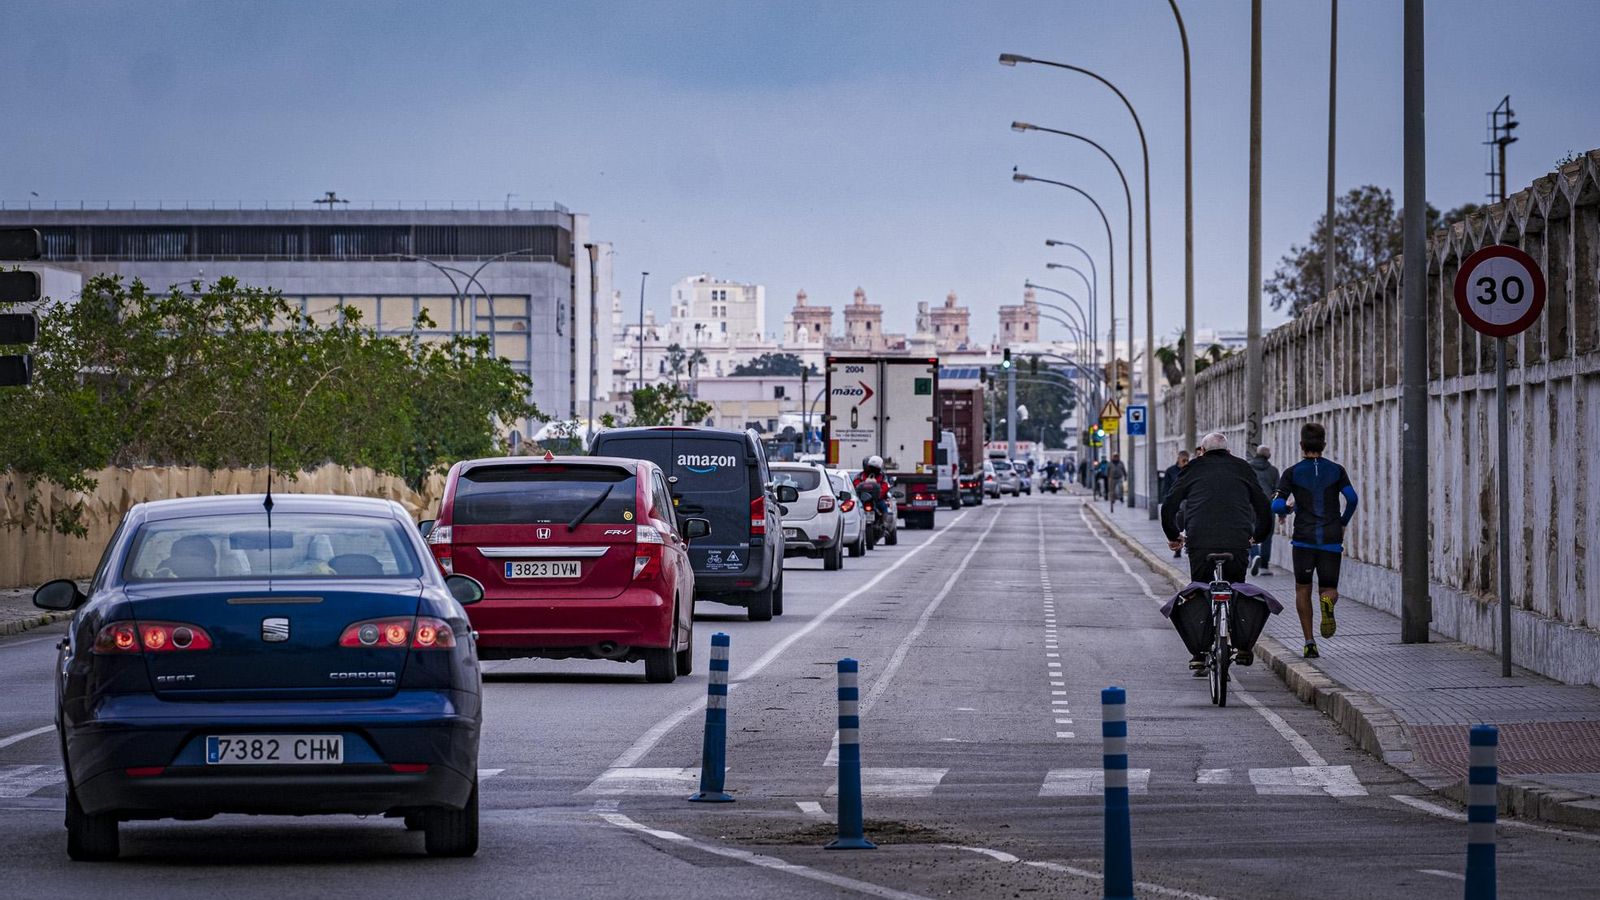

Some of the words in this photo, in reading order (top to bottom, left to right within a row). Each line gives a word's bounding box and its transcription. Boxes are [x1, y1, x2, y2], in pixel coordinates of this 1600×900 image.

[1476, 275, 1525, 306] 30
[845, 365, 865, 374] 2004
[831, 388, 864, 396] mazo
[677, 454, 736, 467] amazon
[515, 563, 548, 576] 3823
[552, 563, 577, 576] DVM
[157, 674, 196, 682] SEAT
[329, 671, 396, 680] CORDOBA
[219, 739, 280, 761] 7382
[294, 739, 340, 761] CHM
